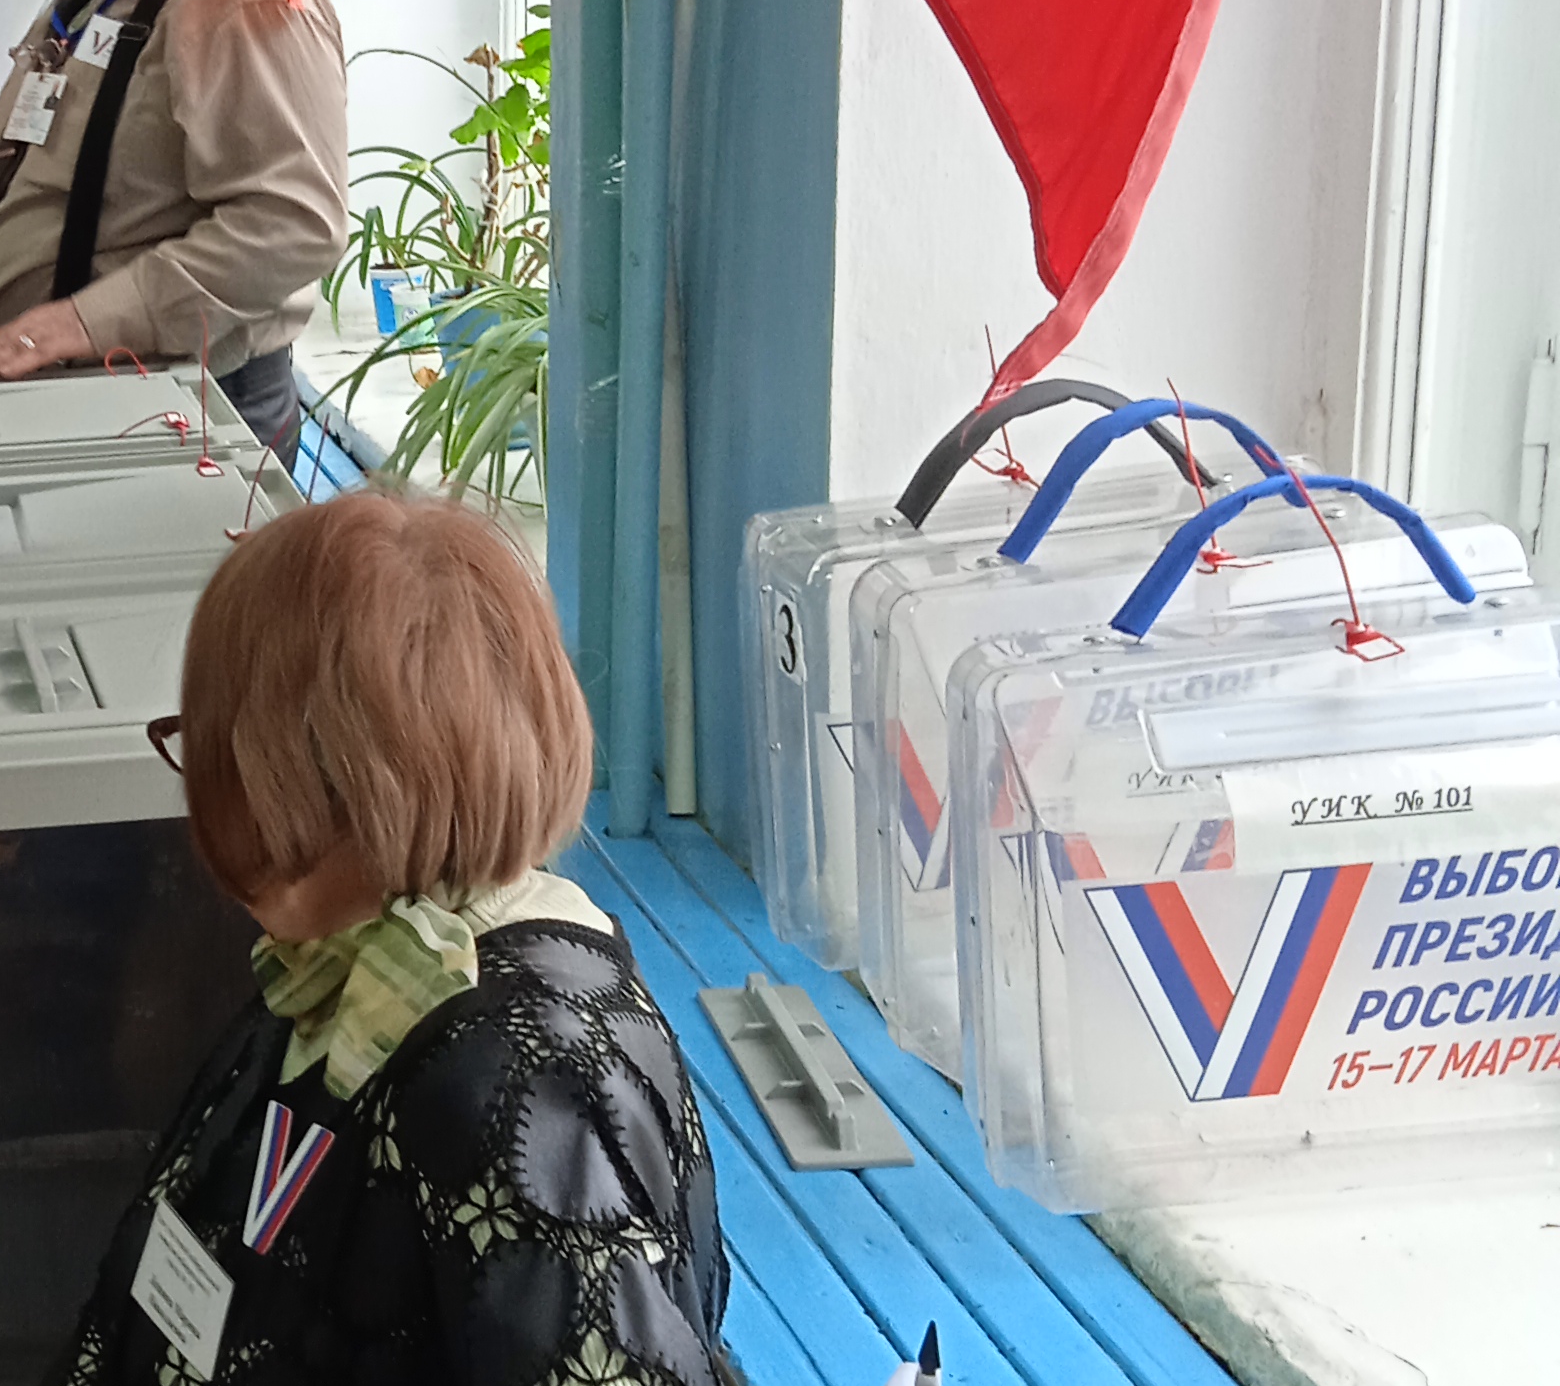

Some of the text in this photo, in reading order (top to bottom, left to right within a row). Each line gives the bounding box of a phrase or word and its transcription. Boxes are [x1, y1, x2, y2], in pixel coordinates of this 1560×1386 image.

[779, 603, 797, 675] 3
[1433, 785, 1473, 809] 101
[1399, 846, 1560, 903] ВЫБО
[1372, 909, 1560, 970] ПРЕЗИ
